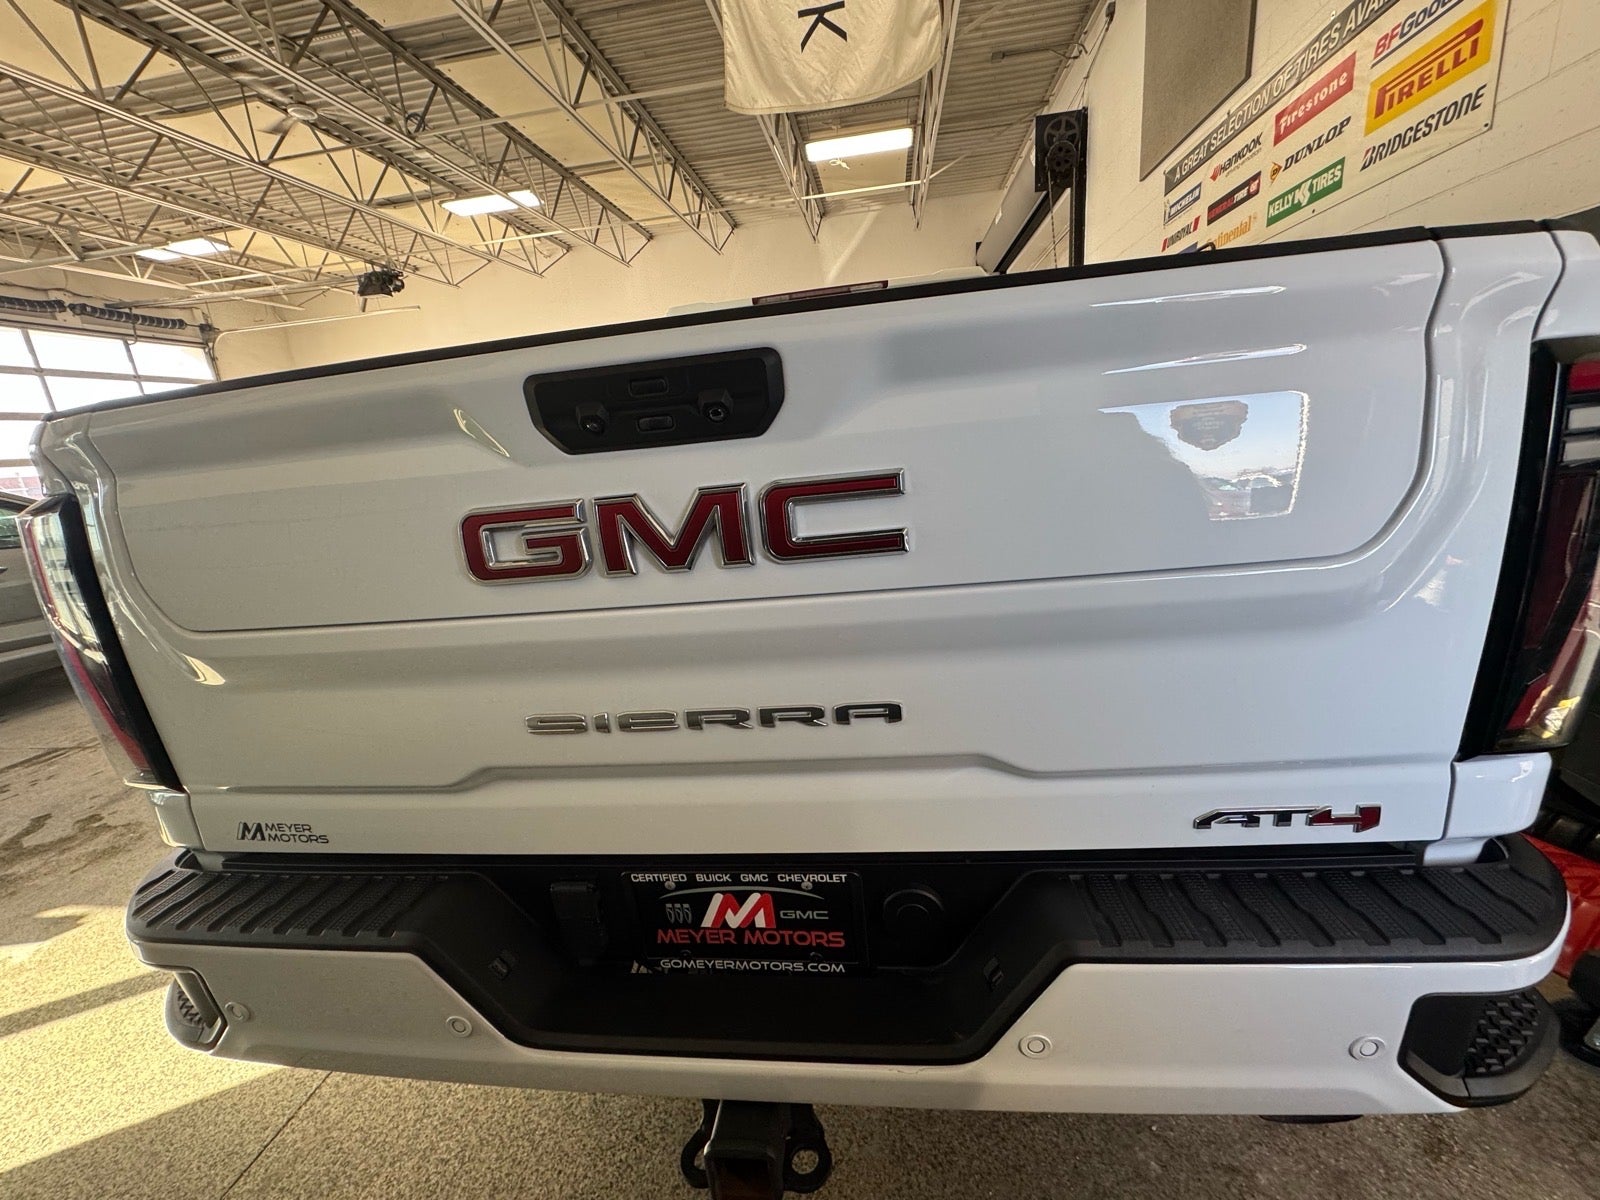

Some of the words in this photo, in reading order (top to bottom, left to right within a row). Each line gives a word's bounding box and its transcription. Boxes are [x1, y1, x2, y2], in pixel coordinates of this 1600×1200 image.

[797, 0, 848, 54] K
[1373, 18, 1484, 120] PIRELLI
[1173, 166, 1181, 183] A
[1181, 139, 1210, 176] GREAT
[1210, 87, 1271, 152] SELECTION
[1273, 65, 1293, 98] OF
[1294, 22, 1341, 78] TIRES
[1279, 71, 1348, 133] Firestone
[1282, 115, 1352, 173] DUNLOP
[1360, 83, 1488, 172] BRIDGESTONE
[1268, 191, 1296, 218] KELLY
[1312, 164, 1343, 194] TIRES
[458, 467, 909, 587] GMC
[525, 700, 904, 735] SIERRA
[264, 822, 313, 833] MEYER
[267, 833, 329, 844] MOTORS
[1193, 803, 1382, 833] AT4
[631, 873, 688, 883] CERTIFIED
[696, 873, 732, 883] BUICK
[740, 873, 769, 883] GMC
[777, 873, 848, 884] CHEVROLET
[779, 909, 829, 920] GMC
[656, 928, 737, 945] MEYER
[743, 930, 846, 948] MOTORS
[660, 958, 846, 973] GOMEYERMOTORS.COM
